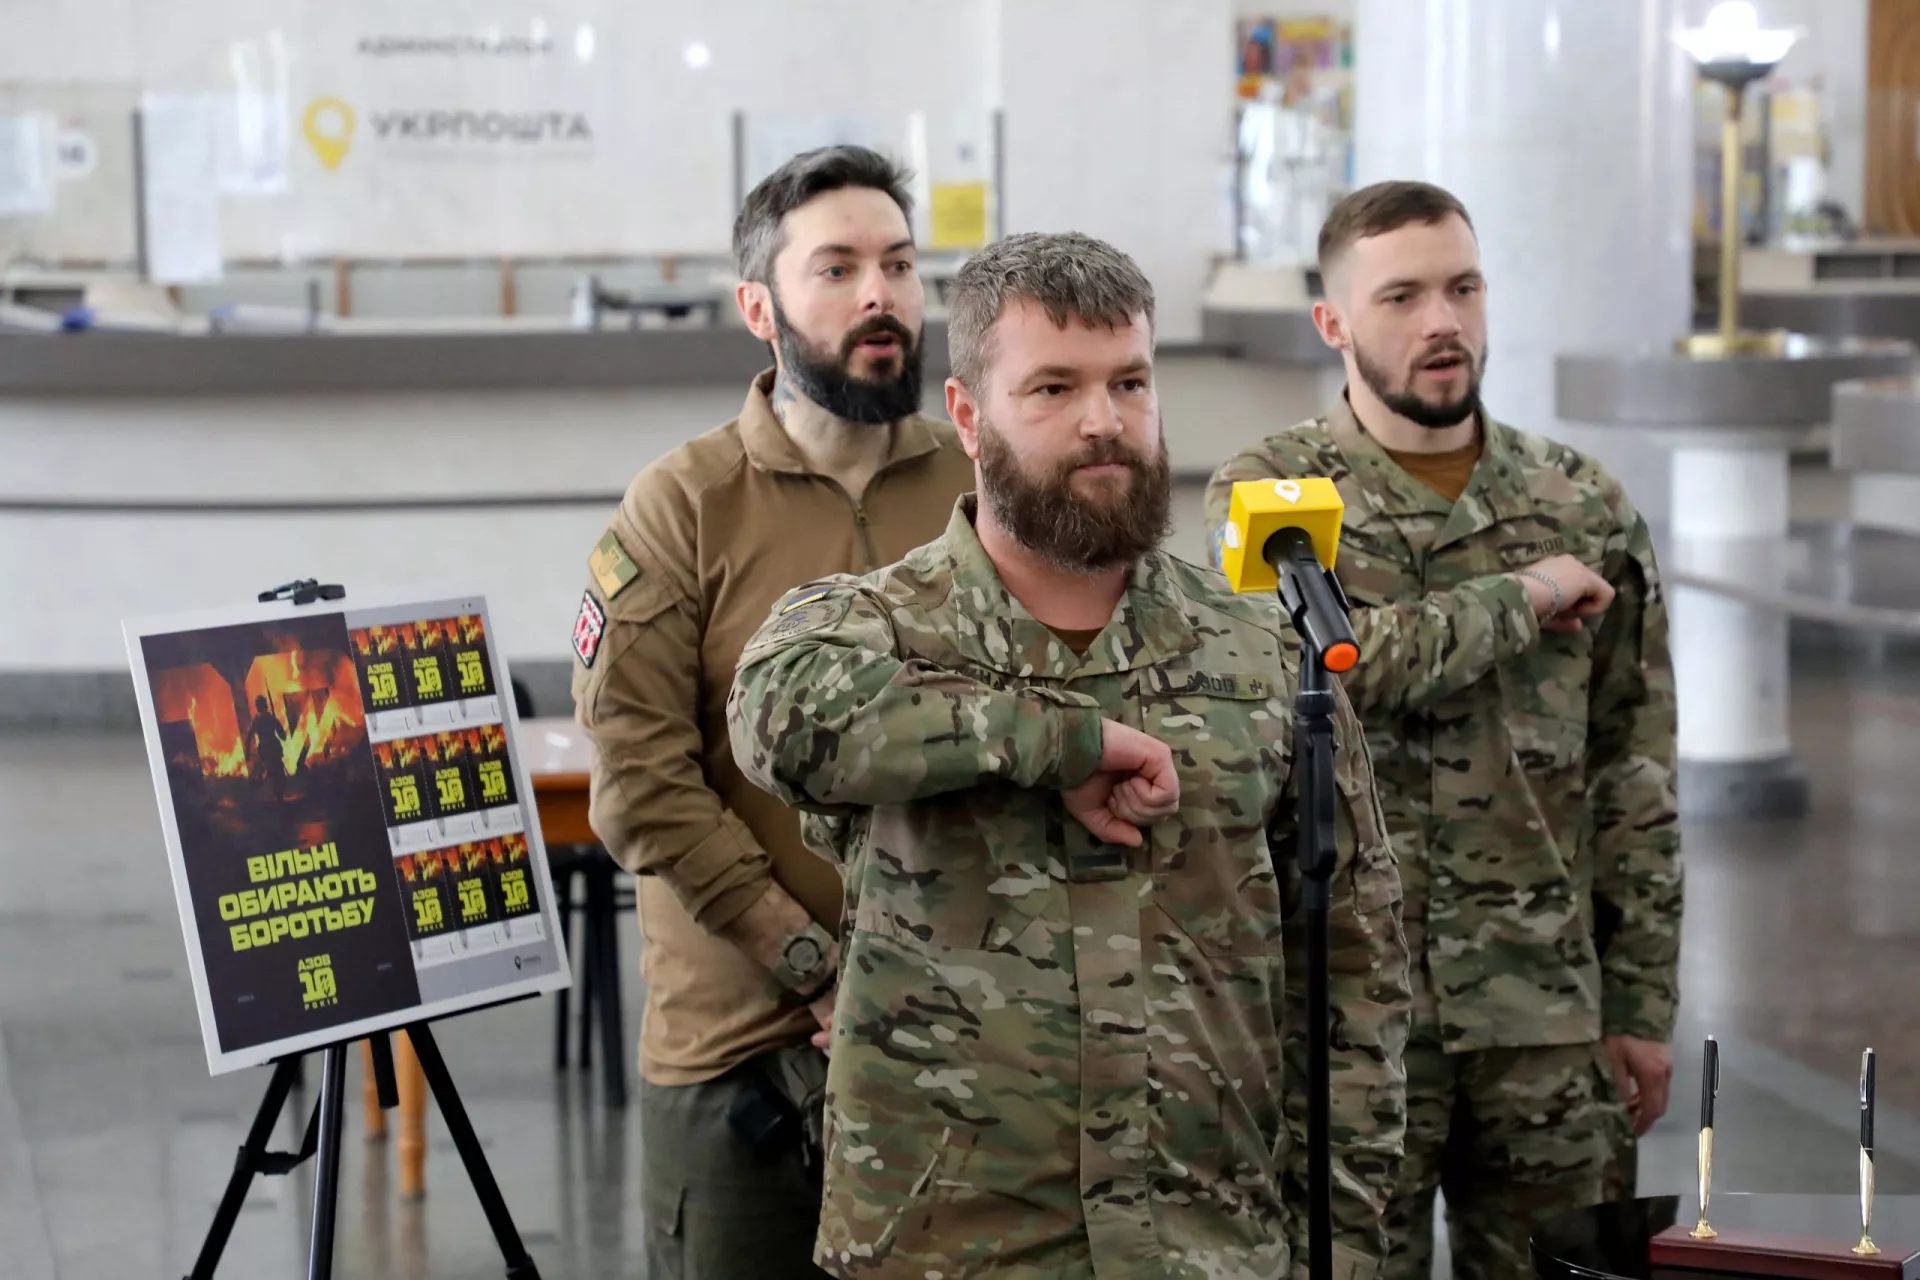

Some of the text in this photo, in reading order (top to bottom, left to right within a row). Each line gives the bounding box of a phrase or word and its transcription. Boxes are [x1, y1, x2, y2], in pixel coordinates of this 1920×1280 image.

[370, 111, 592, 141] УКРПОШТА
[413, 656, 438, 669] АЗОВ
[457, 650, 480, 663] АЗОВ
[367, 662, 393, 675] АЗОВ
[479, 760, 502, 772] АЗОВ
[436, 767, 460, 781] АЗОВ
[390, 775, 415, 788] АЗОВ
[246, 841, 340, 884] ВІЛЬНІ
[501, 869, 524, 881] АЗОВ
[458, 878, 482, 891] АЗОВ
[218, 868, 377, 921] ОБИРАЮТЬ
[413, 887, 438, 901] АЗОВ
[229, 897, 375, 952] БОРОТЬБУ
[298, 953, 331, 971] АЗОВ
[299, 967, 337, 1003] 10
[305, 997, 338, 1011] РОКІВ
